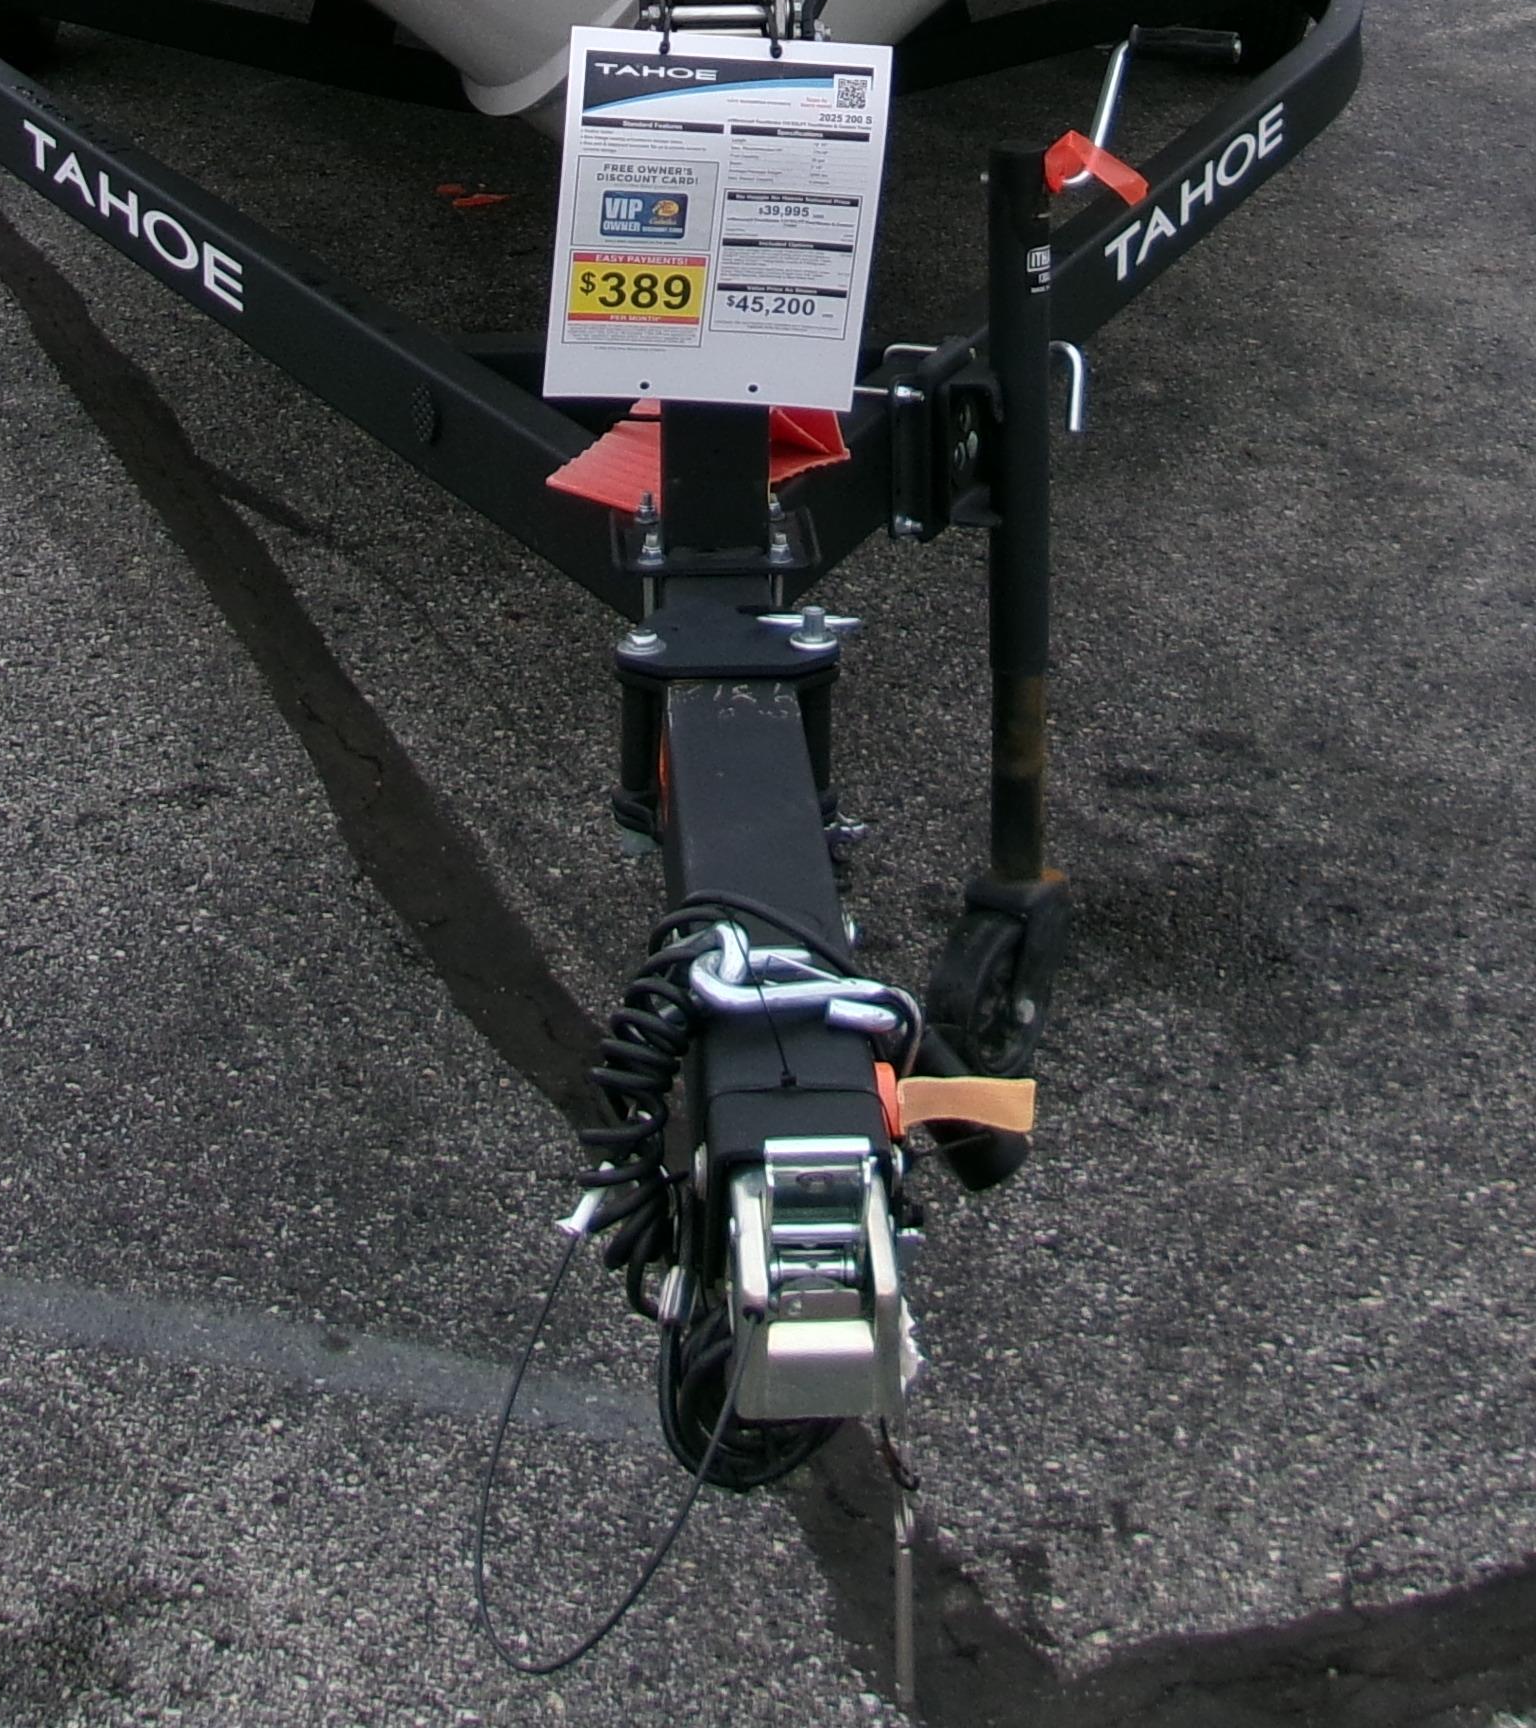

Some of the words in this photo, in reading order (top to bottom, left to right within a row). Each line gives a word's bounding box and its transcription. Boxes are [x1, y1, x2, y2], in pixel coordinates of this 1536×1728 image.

[594, 62, 718, 81] TAHOE
[819, 113, 843, 123] 2025
[844, 114, 863, 124] 200
[603, 163, 634, 173] FREE
[637, 165, 693, 176] OWNER'S
[596, 173, 657, 184] DISCOUNT
[662, 175, 699, 185] CARD!
[1104, 101, 1284, 281] TAHOE
[23, 118, 244, 313] TAHOE
[604, 197, 644, 219] VIP
[758, 205, 810, 218] $39,995
[602, 220, 641, 232] OWNER
[595, 254, 625, 263] EASY
[627, 255, 688, 265] PAYMENTS!
[579, 271, 692, 310] $389
[726, 295, 816, 317] $45,200
